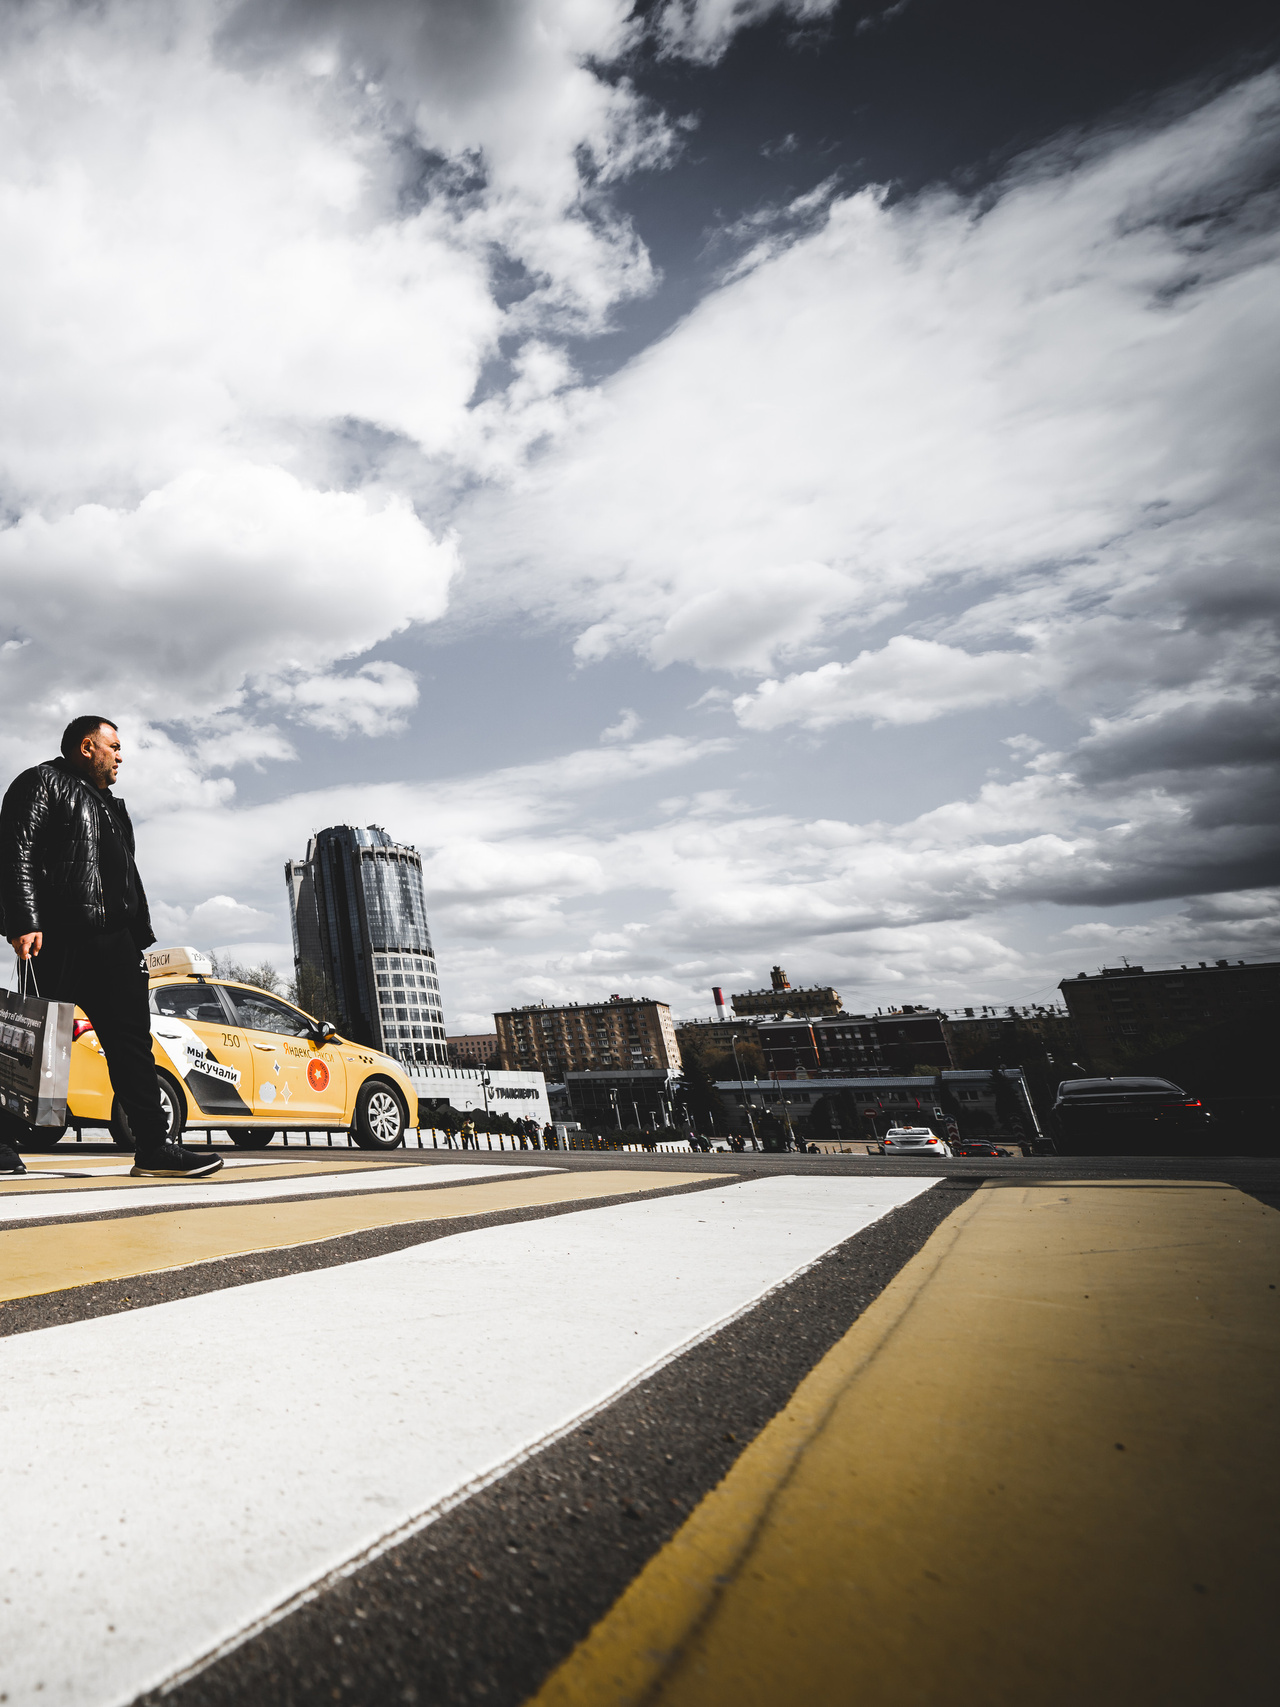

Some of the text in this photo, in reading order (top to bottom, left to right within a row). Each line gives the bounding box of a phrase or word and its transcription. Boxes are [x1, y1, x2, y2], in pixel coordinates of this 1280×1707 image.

[149, 953, 170, 968] Такси
[222, 1033, 241, 1048] 250
[186, 1046, 204, 1059] мы
[283, 1042, 335, 1063] Яндекс Такси
[194, 1059, 238, 1082] скучали
